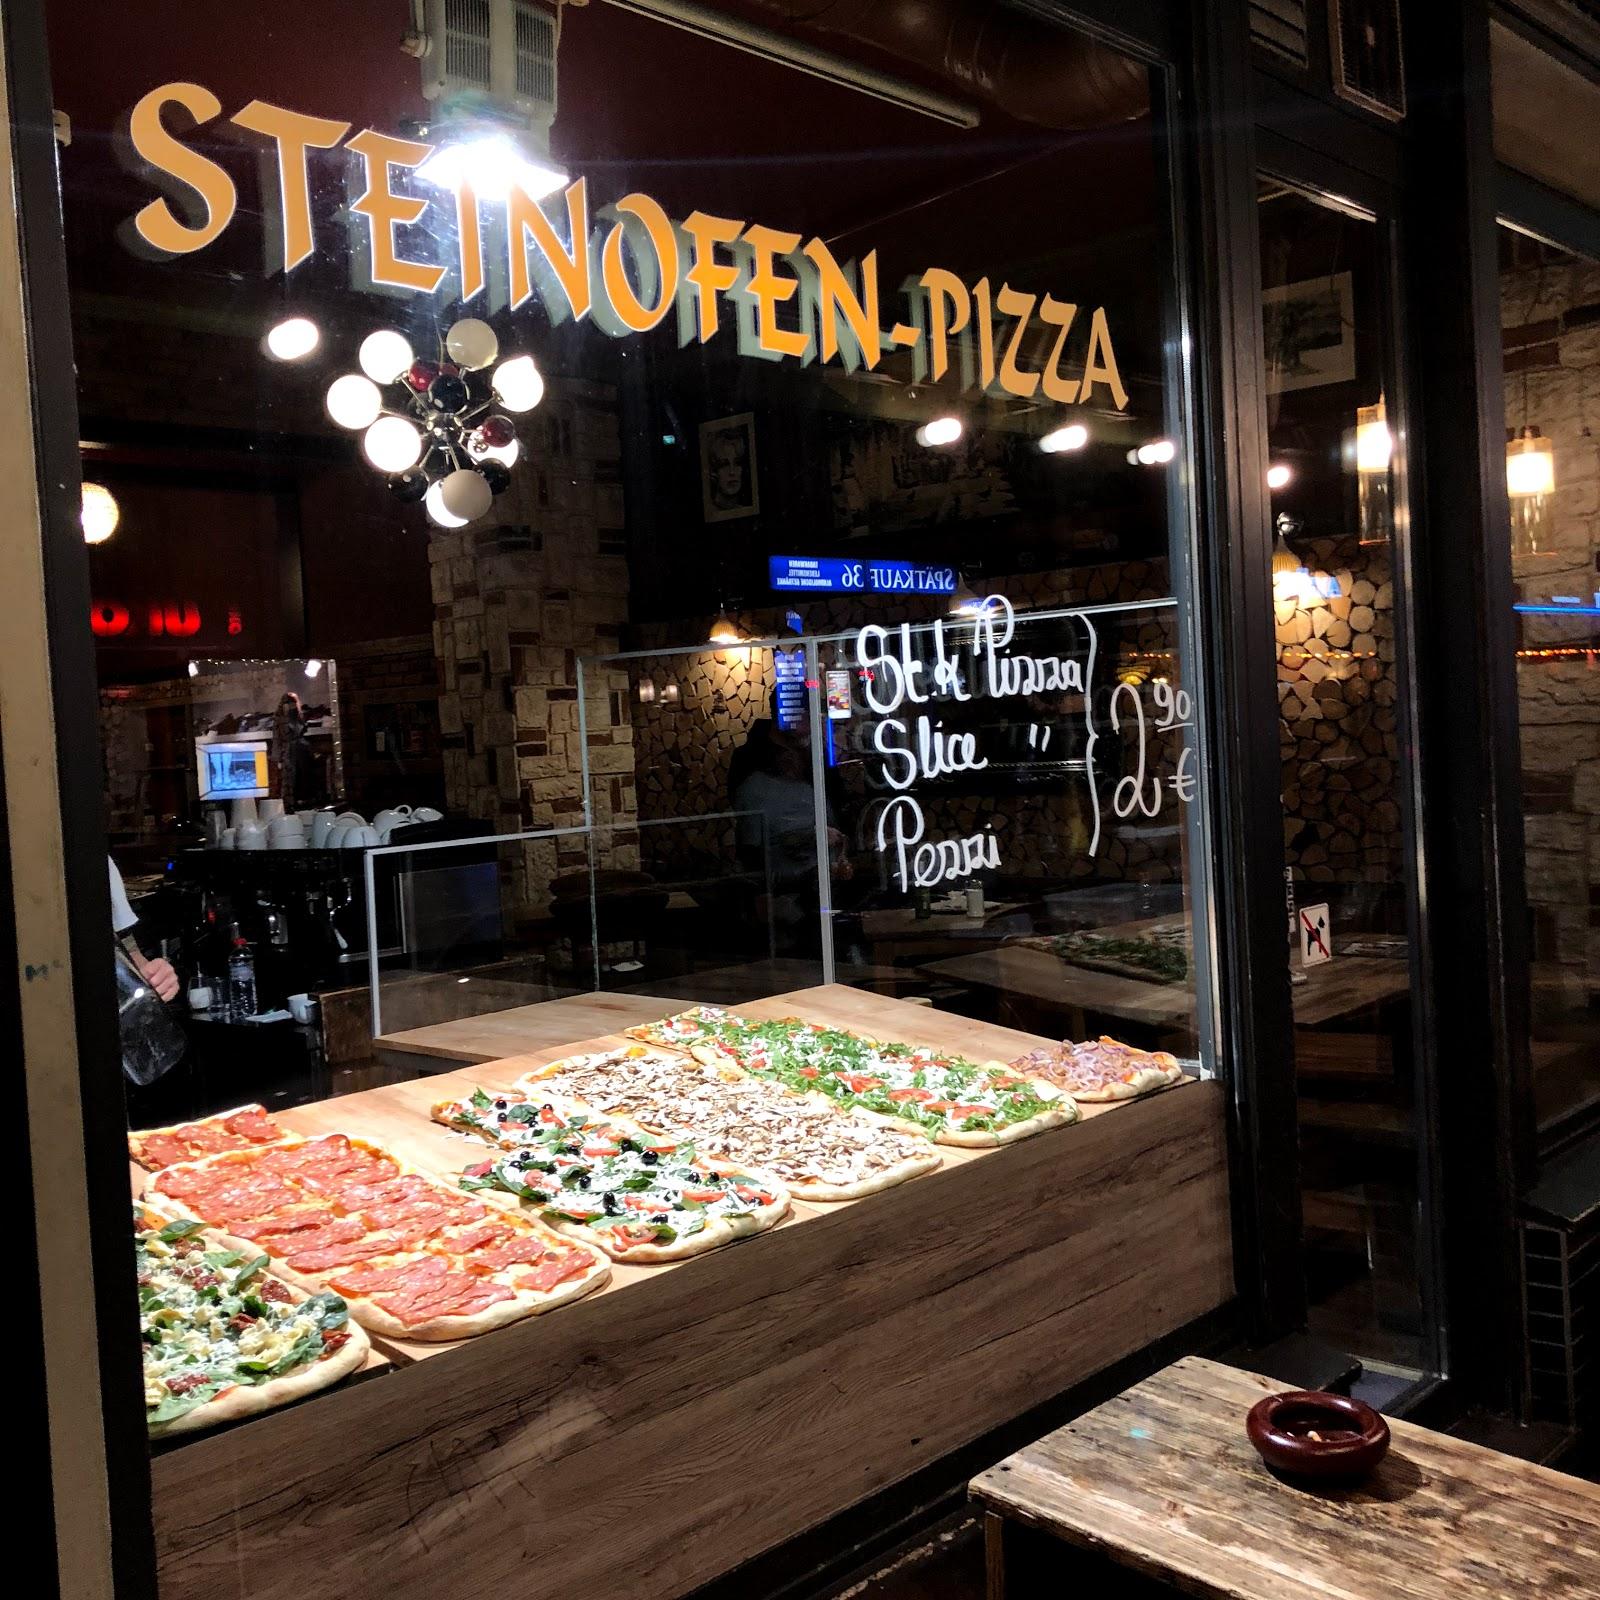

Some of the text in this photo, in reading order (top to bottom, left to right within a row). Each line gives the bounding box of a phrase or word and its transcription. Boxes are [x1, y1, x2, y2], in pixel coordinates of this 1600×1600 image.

[129, 81, 1129, 411] STEINOFEN-PIZZA
[974, 594, 1085, 698] Pizza
[873, 715, 989, 791] Slice
